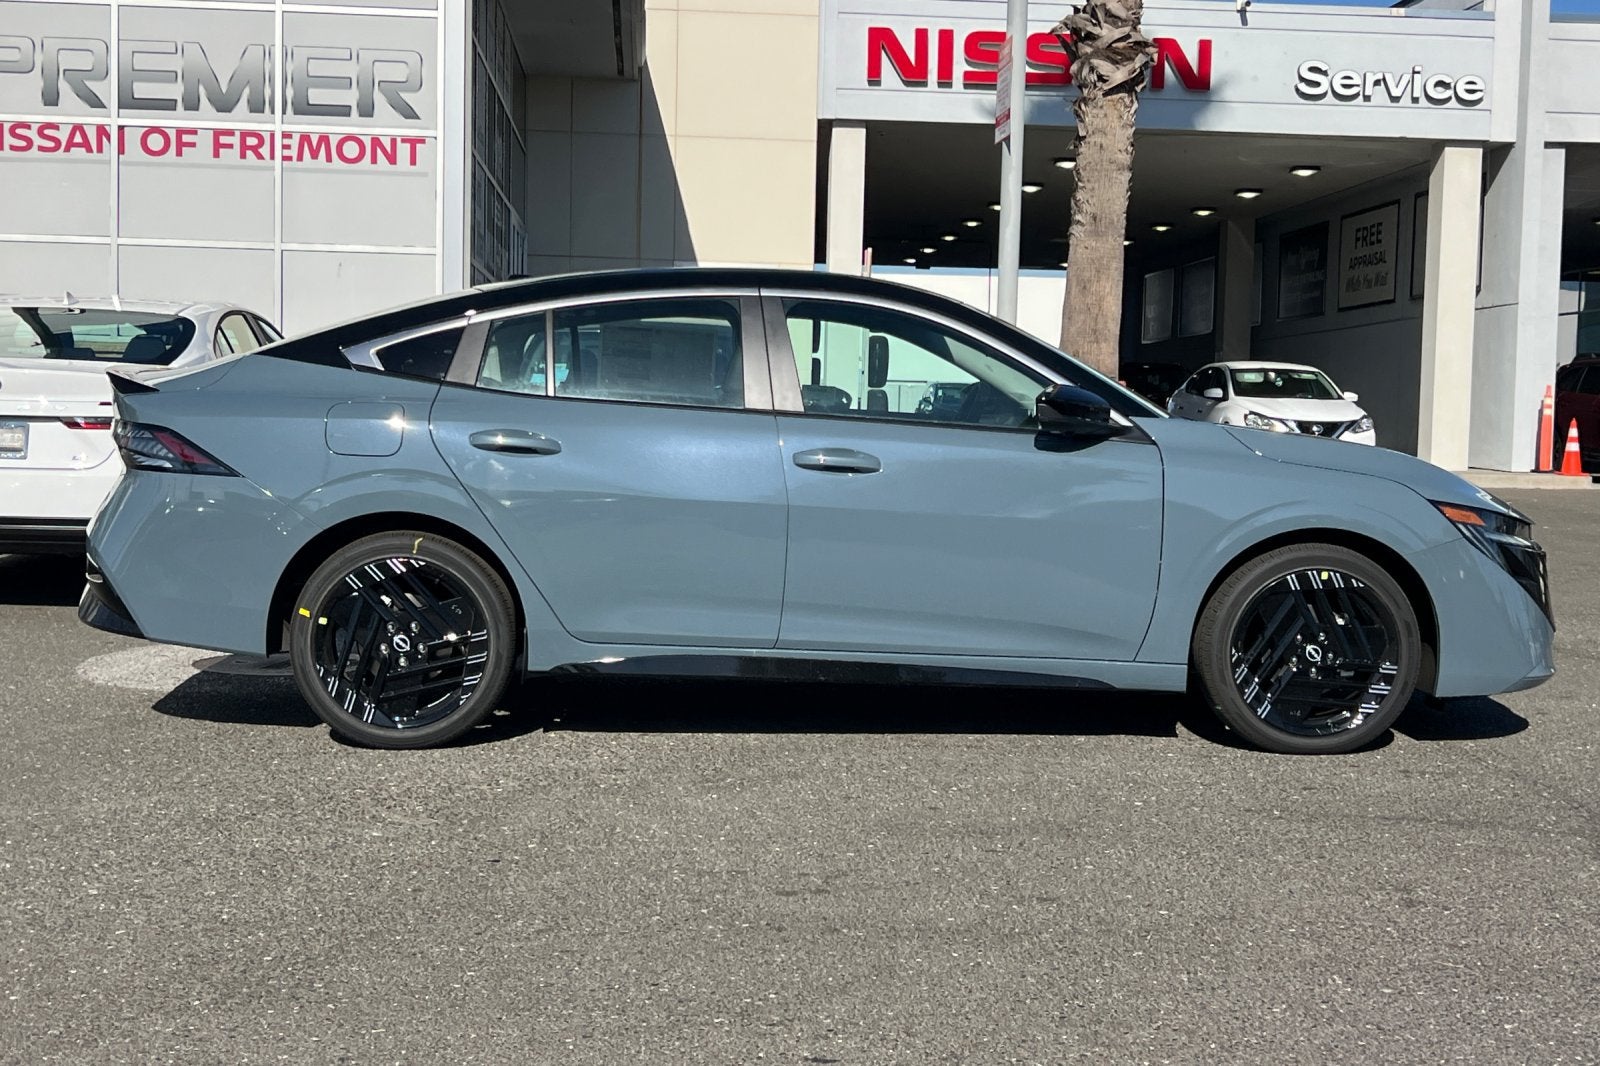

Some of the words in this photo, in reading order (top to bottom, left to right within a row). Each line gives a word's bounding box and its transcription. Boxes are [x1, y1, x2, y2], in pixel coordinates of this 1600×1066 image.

[867, 27, 1212, 90] NISSN
[1295, 60, 1486, 106] Service
[140, 127, 198, 157] OF
[212, 130, 426, 166] FREMONT
[1354, 222, 1384, 249] FREE
[1348, 250, 1387, 271] APPRAISAL
